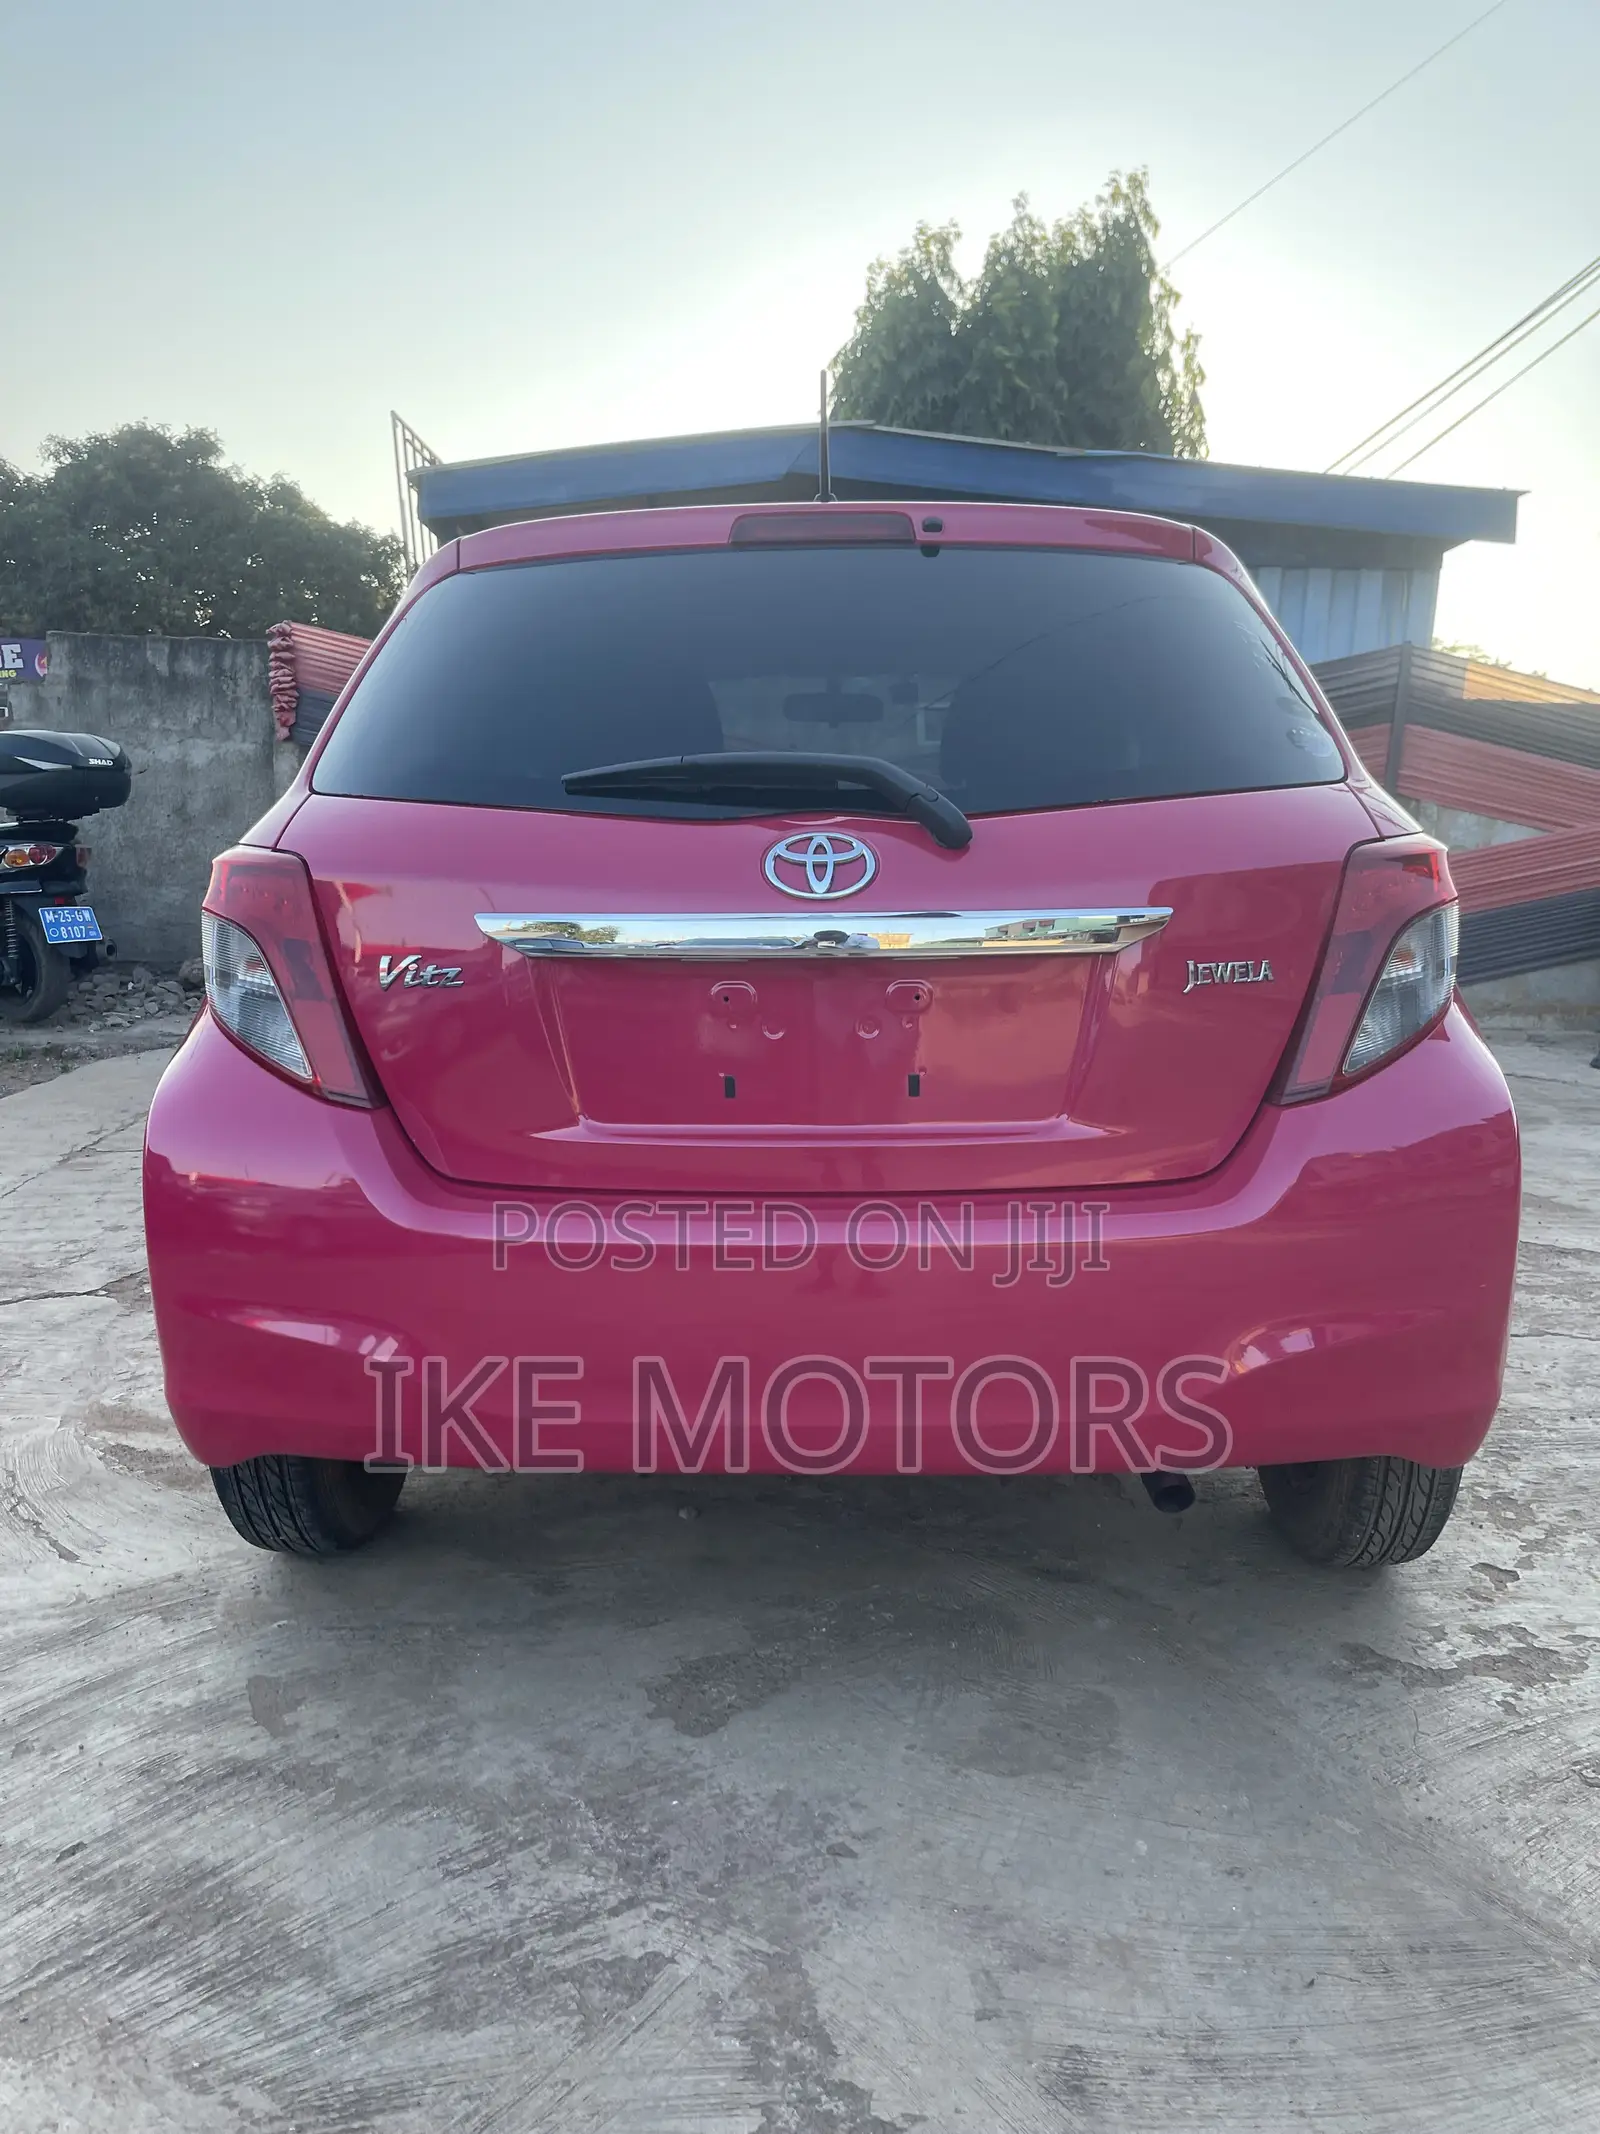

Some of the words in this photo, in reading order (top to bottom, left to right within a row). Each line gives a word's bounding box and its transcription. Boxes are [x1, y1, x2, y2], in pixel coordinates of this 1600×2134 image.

[0, 644, 24, 669] E
[88, 758, 114, 766] SHAD
[60, 925, 86, 939] 8107
[379, 954, 465, 993] Vitz
[1183, 959, 1275, 994] JEWELA
